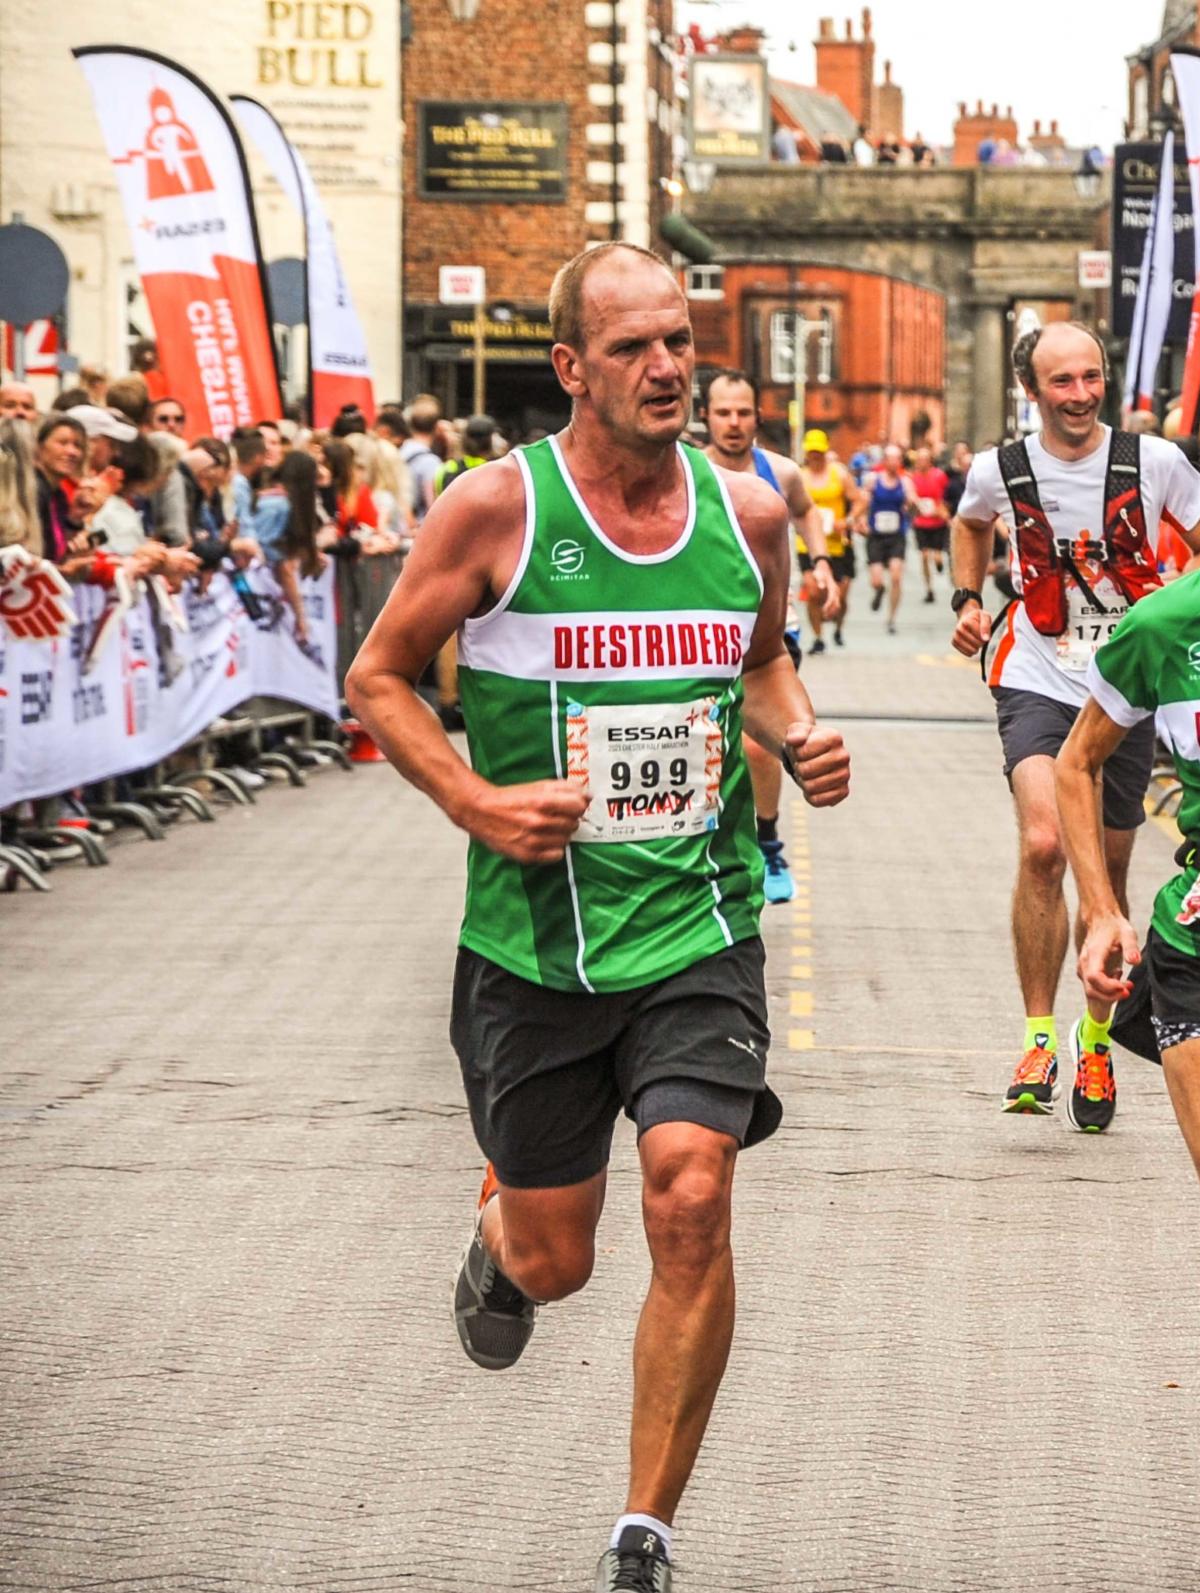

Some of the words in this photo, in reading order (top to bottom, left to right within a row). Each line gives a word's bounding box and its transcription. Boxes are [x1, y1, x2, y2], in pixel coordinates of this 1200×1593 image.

[266, 1, 373, 40] PIED
[256, 47, 383, 88] BULL
[1081, 606, 1128, 615] ESAR
[554, 623, 743, 670] DEESTRIDERS
[608, 725, 690, 742] ESSAR
[610, 758, 688, 791] 999
